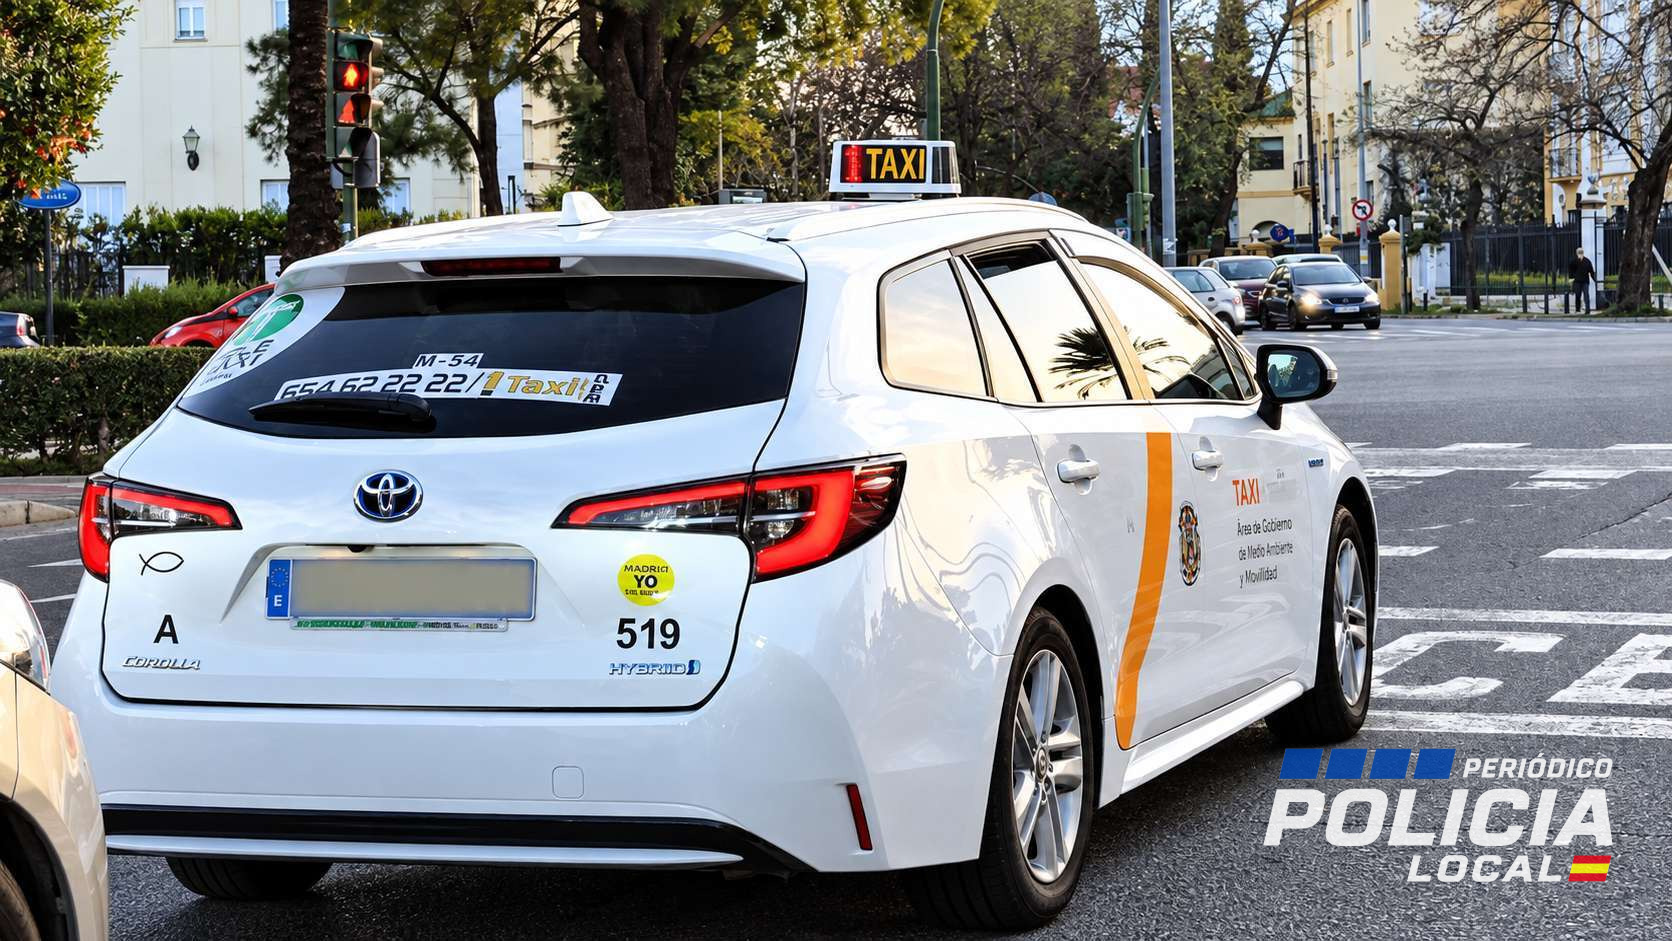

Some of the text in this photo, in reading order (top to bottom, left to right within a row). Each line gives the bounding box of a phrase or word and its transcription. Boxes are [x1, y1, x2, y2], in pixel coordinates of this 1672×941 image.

[866, 148, 925, 179] TAXI
[414, 354, 480, 367] M-54
[380, 374, 423, 393] 22
[1232, 478, 1260, 506] TAXI
[1253, 520, 1261, 534] de
[1238, 546, 1247, 560] de
[633, 575, 658, 588] YO
[1239, 574, 1244, 589] y
[273, 595, 283, 607] E
[153, 614, 179, 645] A
[616, 618, 681, 650] 519
[122, 656, 201, 671] COROLLA
